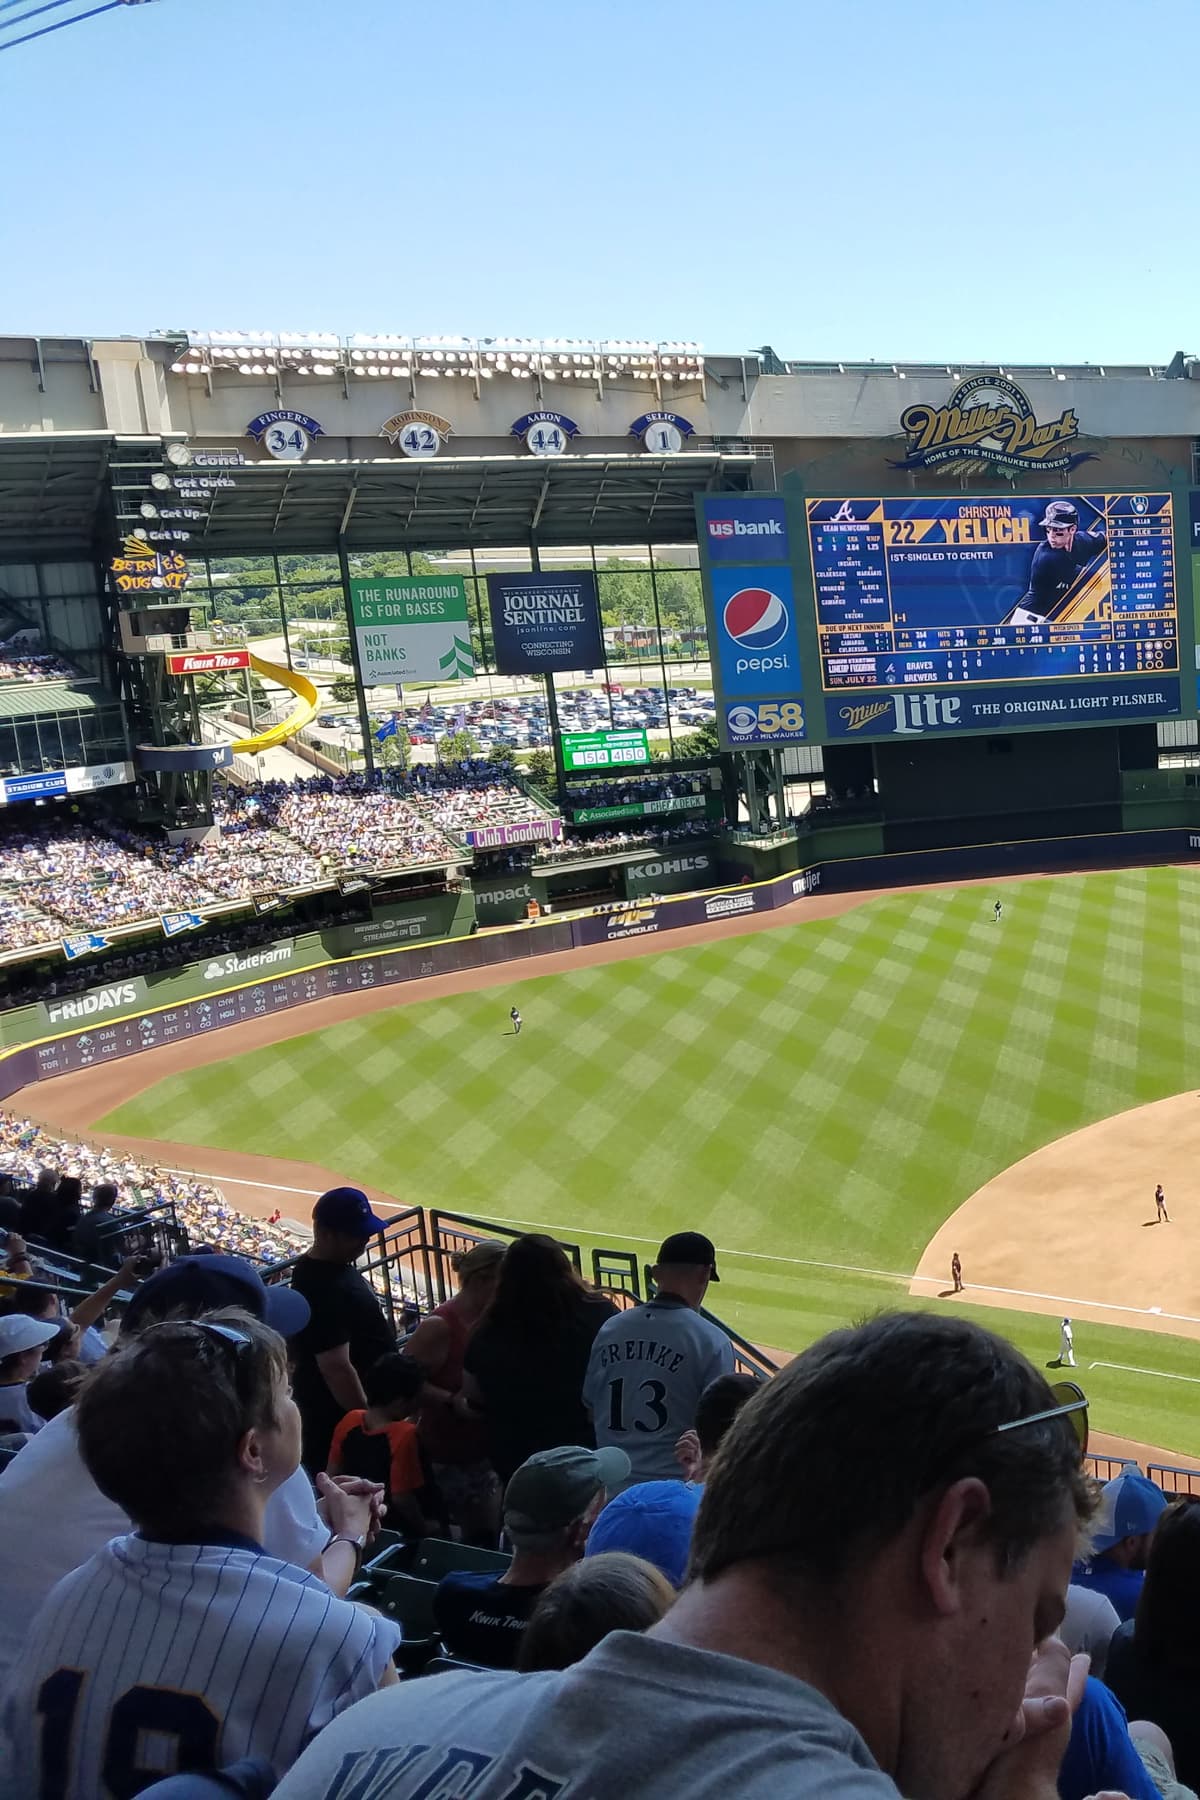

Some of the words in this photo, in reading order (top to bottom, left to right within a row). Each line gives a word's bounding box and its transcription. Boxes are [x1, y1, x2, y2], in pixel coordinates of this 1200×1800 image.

[961, 378, 992, 394] SINCE
[994, 378, 1016, 394] 2001
[258, 411, 308, 426] FINGERS
[391, 411, 443, 428] ROBINSON
[527, 413, 561, 423] AARON
[646, 412, 676, 422] SELIG
[903, 403, 1012, 450] Miller
[990, 409, 1078, 457] Park
[270, 430, 304, 452] 34
[403, 430, 435, 450] 42
[531, 429, 561, 450] 44
[657, 431, 671, 451] 1
[194, 454, 245, 466] Gone!
[924, 452, 948, 465] HOME
[949, 449, 961, 458] OF
[962, 449, 980, 457] THE
[981, 450, 1030, 468] MILWAUKEE
[1031, 458, 1070, 469] BREWERS
[174, 478, 198, 488] Get
[199, 477, 236, 487] Outta
[180, 489, 211, 498] Here
[159, 509, 182, 519] Get
[184, 508, 200, 520] Up
[958, 506, 1012, 519] CHRISTIAN
[150, 531, 172, 540] Get
[173, 530, 190, 541] Up
[890, 520, 916, 544] 22
[939, 518, 1031, 544] YELICH
[890, 552, 945, 562] 1ST-SINGLED
[947, 553, 958, 561] TO
[959, 552, 994, 560] CENTER
[357, 589, 381, 602] THE
[385, 586, 459, 601] RUNAROUND
[361, 605, 373, 618] IS
[377, 604, 402, 617] FOR
[406, 602, 445, 616] BASES
[503, 594, 584, 612] JOURNAL
[504, 608, 586, 626] SENTINEL
[838, 624, 846, 632] UP
[863, 623, 885, 631] INNING
[364, 634, 388, 647] NOT
[521, 641, 574, 650] CONNECTING
[367, 648, 407, 662] BANKS
[526, 648, 571, 657] WISCONSIN
[183, 657, 215, 671] KWIK
[214, 655, 240, 668] TRIP
[736, 654, 788, 675] pepsi
[906, 661, 934, 670] BRAVES
[845, 675, 866, 684] JULY
[866, 675, 877, 683] 22
[904, 672, 938, 682] BREWERS
[757, 702, 804, 733] 58
[839, 701, 894, 730] Miller
[890, 694, 961, 734] Lite
[972, 703, 1001, 716] THE
[1004, 699, 1067, 714] ORIGINAL
[1070, 696, 1110, 710] LIGHT
[1112, 692, 1167, 706] PILSNER.
[731, 734, 753, 742] WDJT
[760, 731, 804, 740] MILWAUKEE
[7, 782, 44, 794] STADIUM
[45, 779, 65, 788] CLUB
[650, 801, 678, 812] CHECK
[476, 827, 501, 848] Club
[504, 821, 554, 844] Goodwill
[628, 855, 709, 880] KOHL'S
[792, 870, 821, 895] meijer
[607, 924, 659, 940] CHEVROLET
[49, 983, 138, 1023] FRIDAYS
[162, 1013, 178, 1023] TEX
[164, 1025, 179, 1036] DET
[219, 1009, 235, 1020] HOU
[39, 1047, 56, 1058] NYY
[100, 1030, 117, 1041] OAK
[41, 1060, 58, 1071] TOR
[102, 1043, 117, 1053] CLE
[600, 1340, 684, 1374] GREINKE
[607, 1378, 668, 1433] 13
[469, 1609, 501, 1626] KWIK
